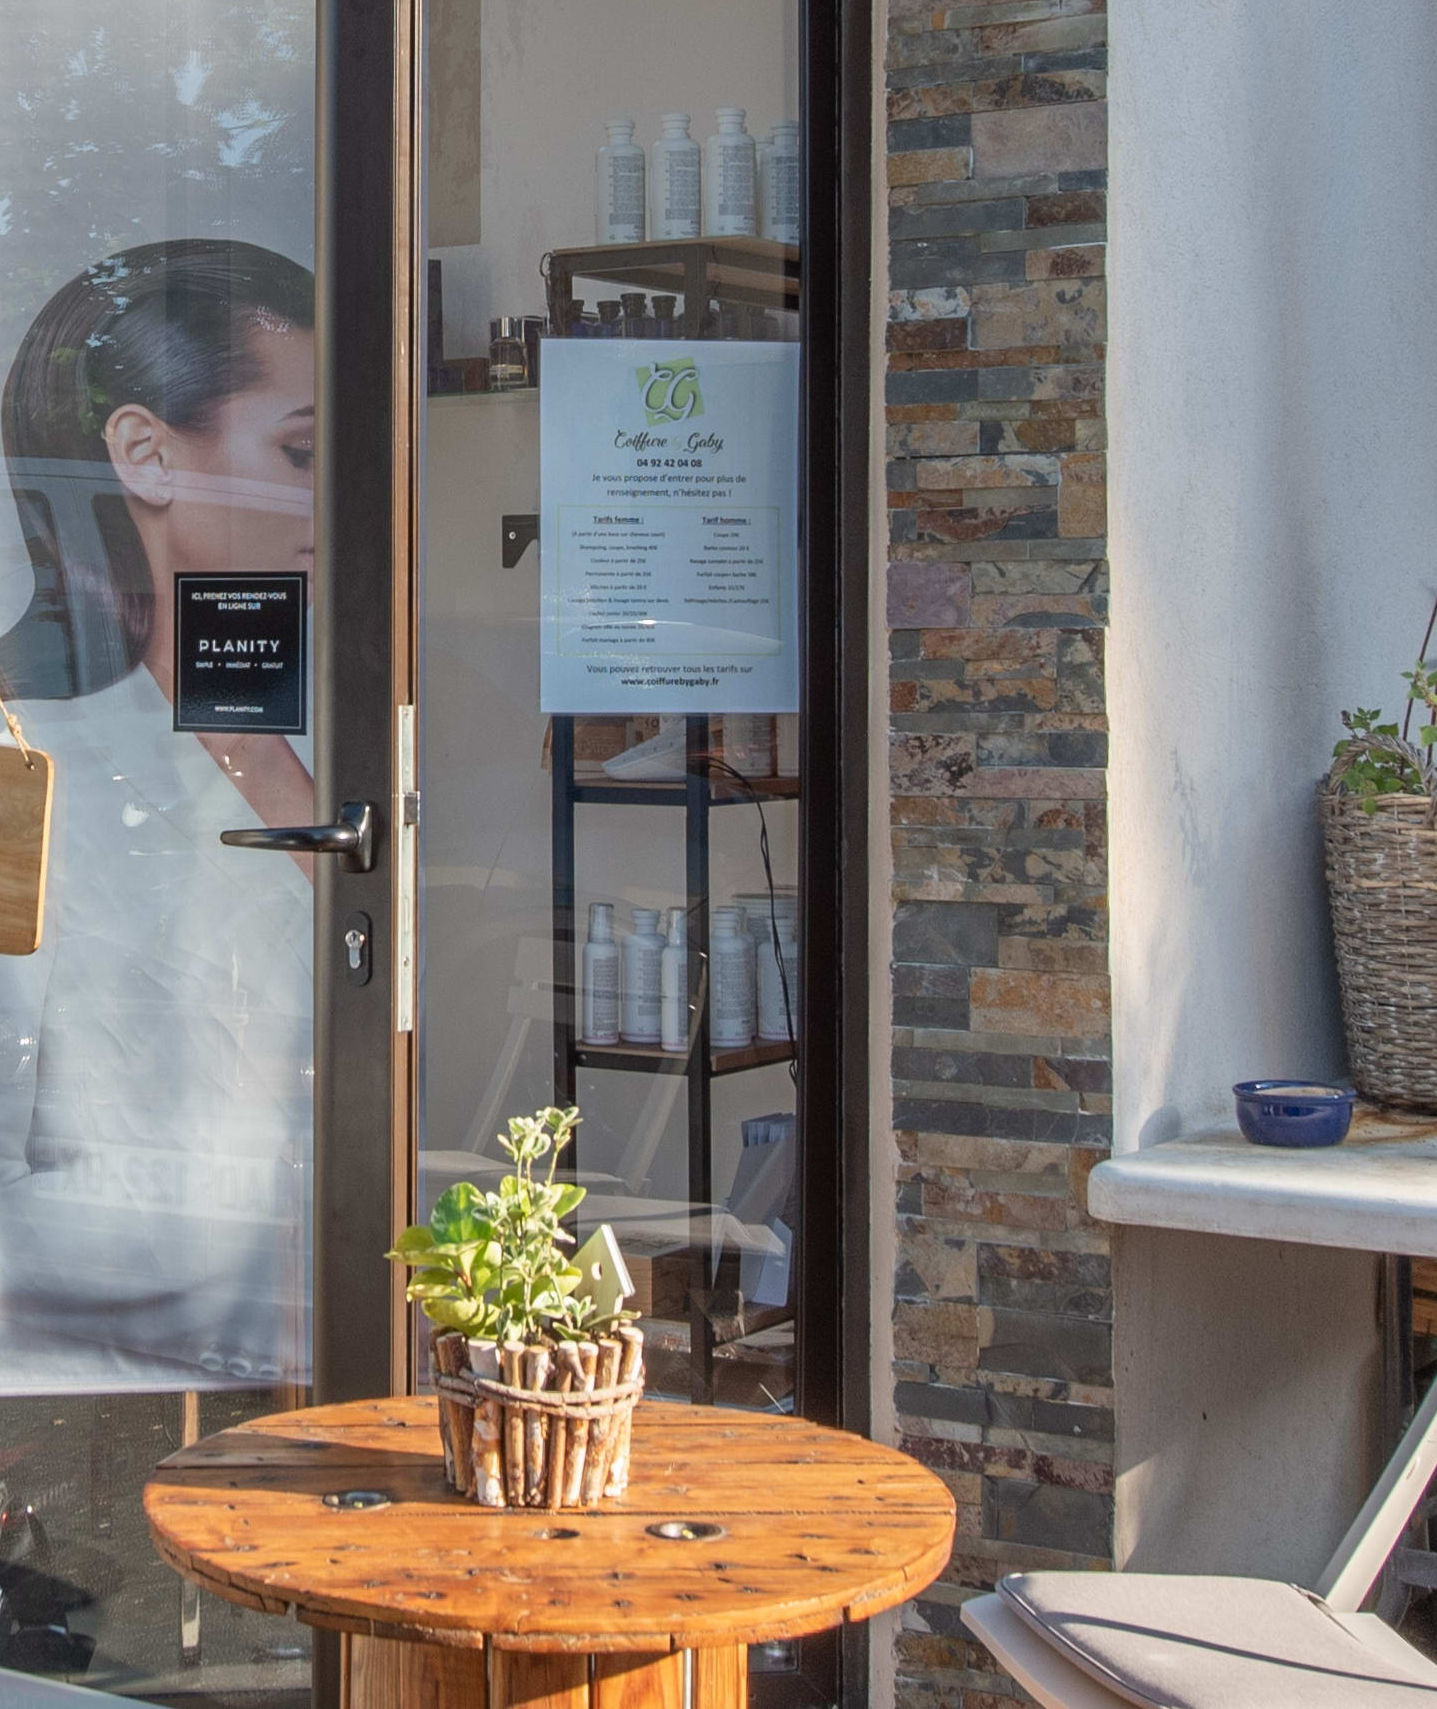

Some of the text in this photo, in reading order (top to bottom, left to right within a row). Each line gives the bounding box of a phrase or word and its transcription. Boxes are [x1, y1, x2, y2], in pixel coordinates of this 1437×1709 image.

[614, 429, 667, 451] Coiffure
[683, 432, 724, 453] Gaby
[637, 459, 702, 467] 04 92 42 04 08
[592, 474, 600, 482] Je
[624, 475, 658, 483] propose
[717, 474, 733, 483] plus
[736, 475, 746, 483] de
[607, 489, 671, 498] renseignement,
[712, 490, 726, 498] pas
[199, 640, 280, 653] PLANITY
[587, 665, 607, 673] Vous
[609, 666, 639, 674] pouvez
[642, 665, 680, 673] retrouver
[683, 665, 701, 673] tous
[703, 665, 715, 673] les
[717, 665, 738, 673] tarifs
[621, 678, 719, 687] www.coiffurebygaby.fr
